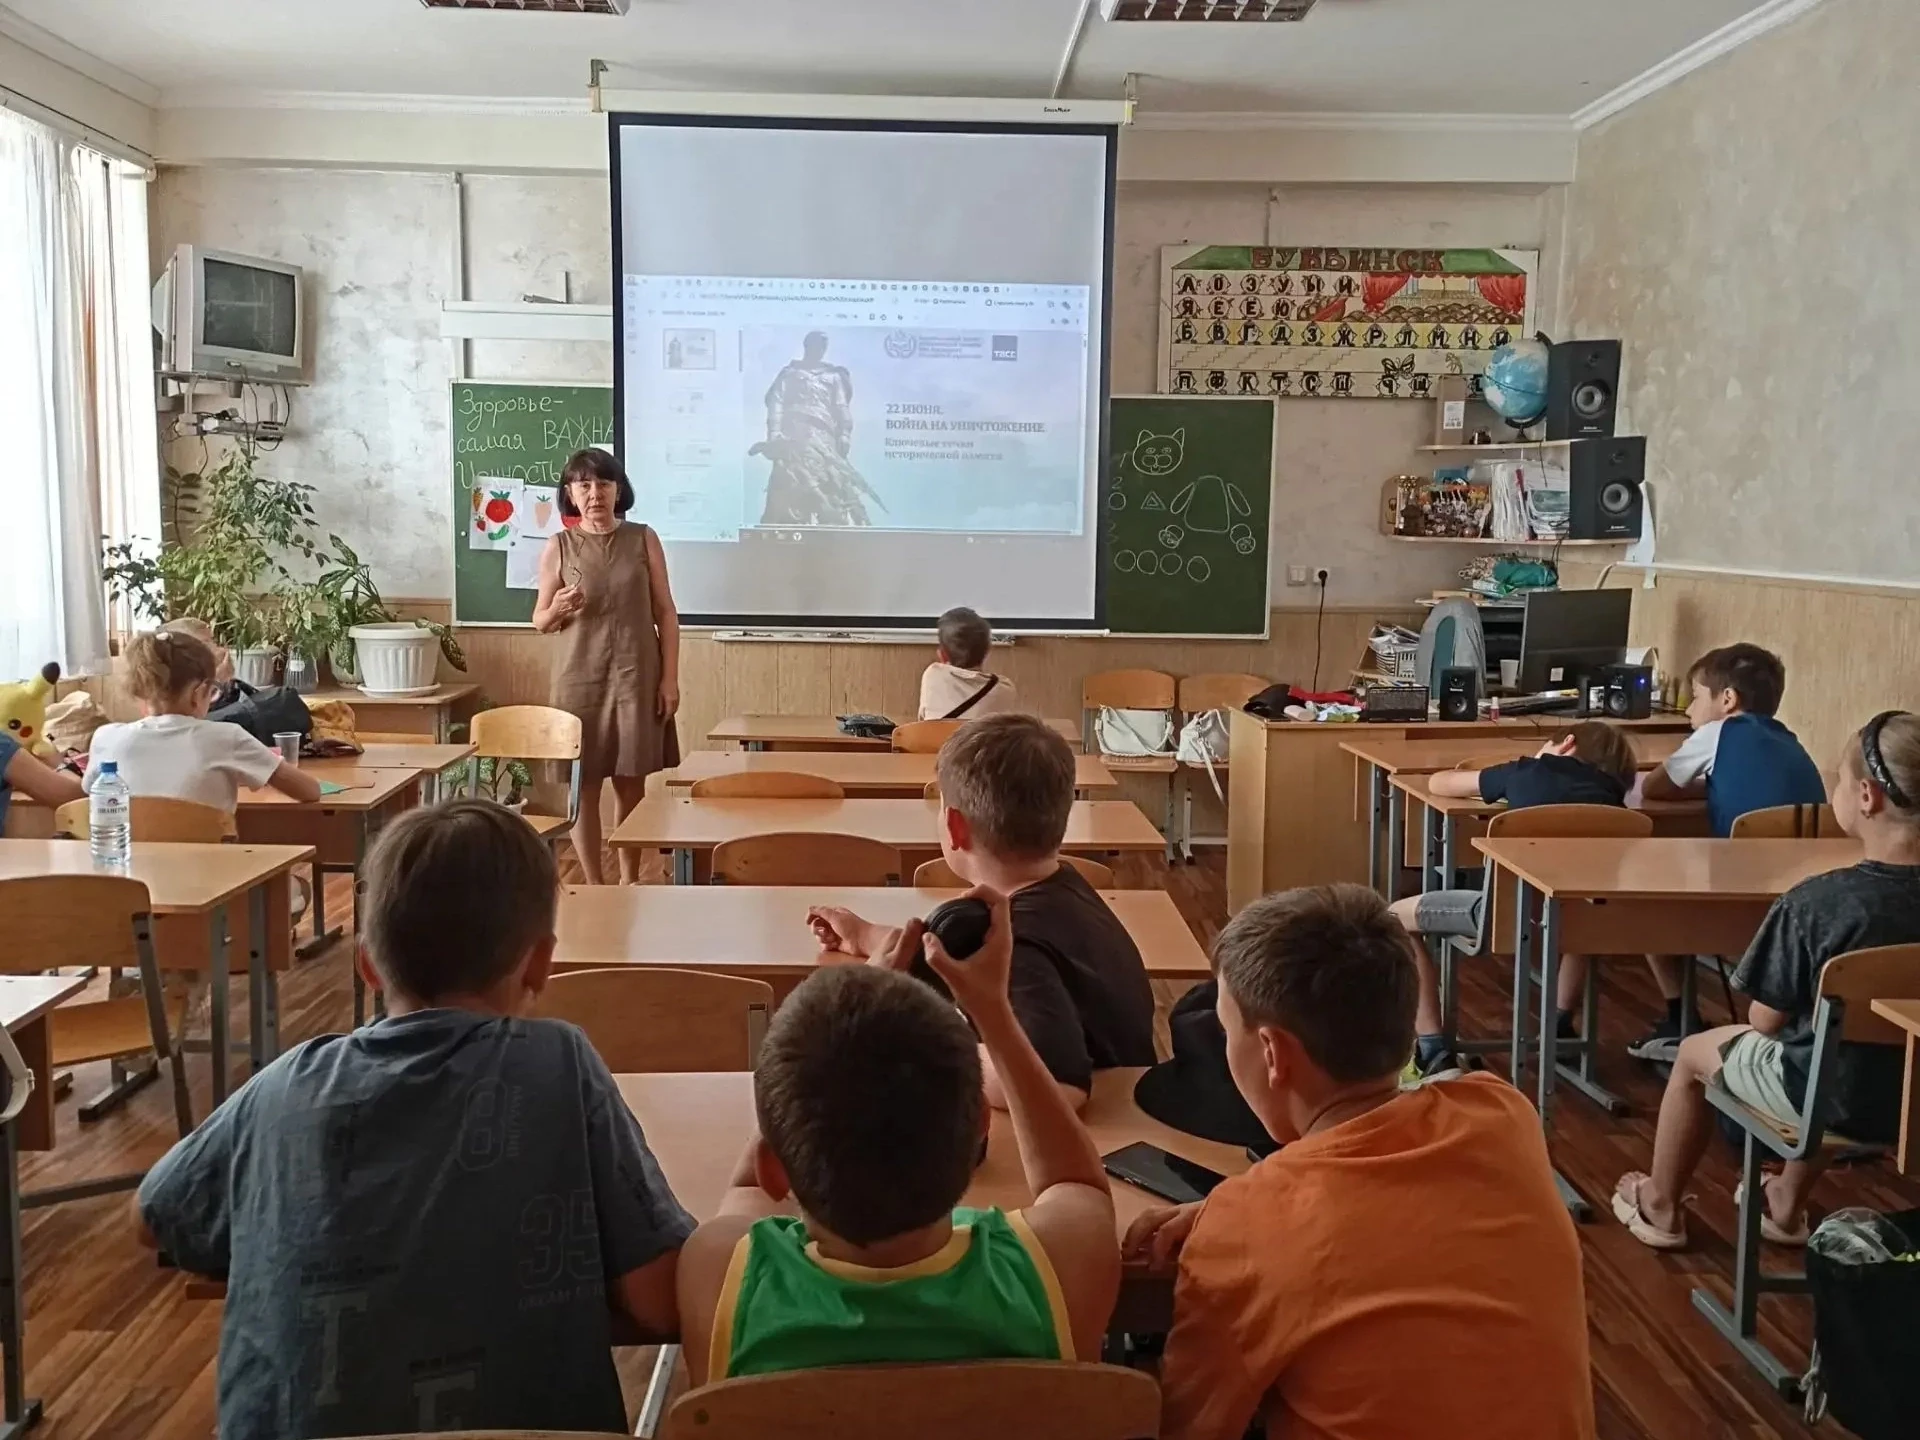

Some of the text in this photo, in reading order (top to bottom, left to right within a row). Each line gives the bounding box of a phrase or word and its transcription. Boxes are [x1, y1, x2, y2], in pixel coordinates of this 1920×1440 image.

[886, 403, 900, 414] 22
[931, 420, 947, 431] НА
[456, 433, 526, 453] самая
